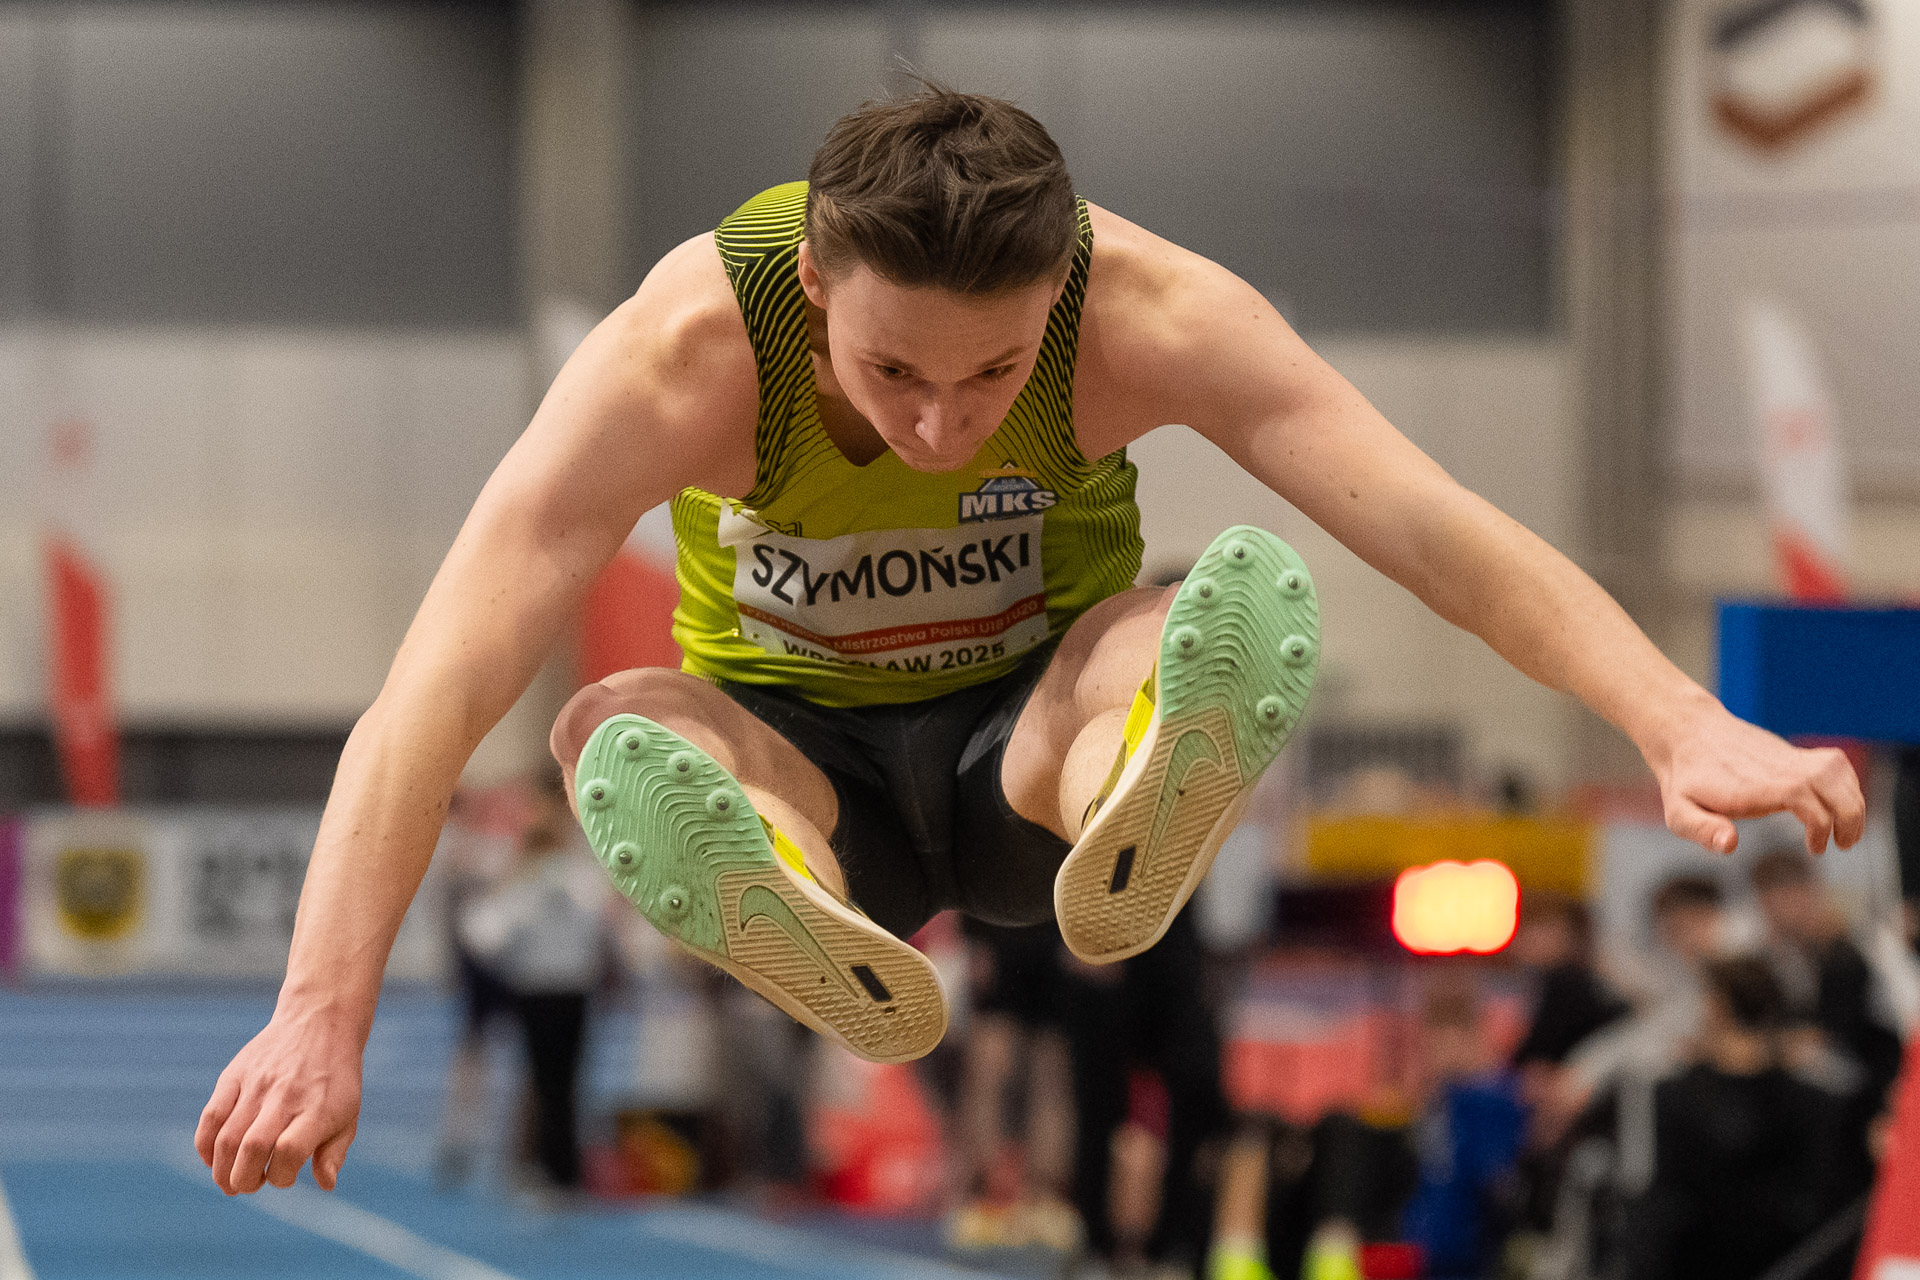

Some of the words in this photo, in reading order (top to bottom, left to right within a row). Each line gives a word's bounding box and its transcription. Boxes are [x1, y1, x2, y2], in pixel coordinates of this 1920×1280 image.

[962, 491, 1057, 518] MKS
[752, 533, 1029, 606] SZYMOŃSKI
[834, 629, 926, 651] Mistrzostwa
[930, 622, 975, 638] Polski
[1012, 600, 1038, 619] U20
[939, 641, 1005, 669] 2025
